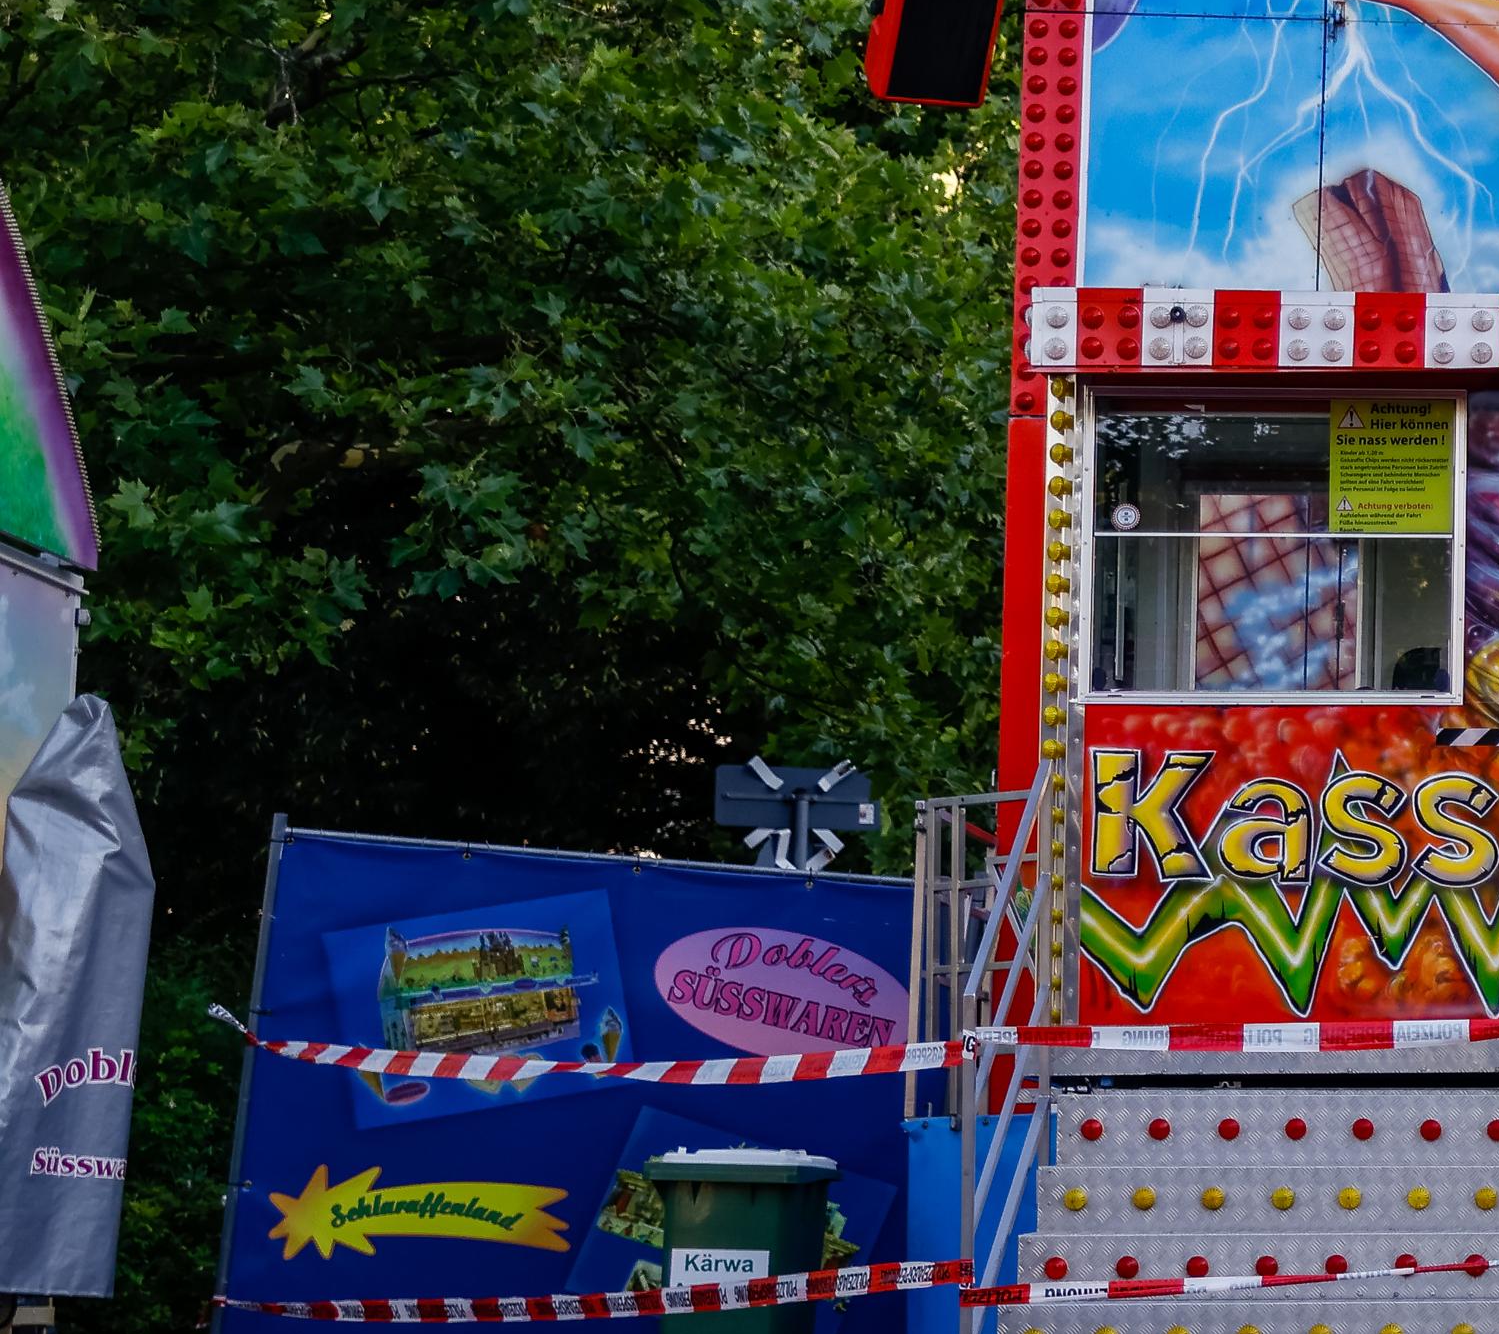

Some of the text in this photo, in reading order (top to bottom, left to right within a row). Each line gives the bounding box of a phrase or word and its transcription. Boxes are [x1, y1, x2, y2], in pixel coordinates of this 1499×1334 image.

[1370, 403, 1431, 417] Achtung!
[1370, 418, 1449, 430] Hier können
[1336, 434, 1355, 446] Sie
[1358, 436, 1387, 446] nass
[1390, 434, 1438, 446] werden
[1357, 502, 1434, 511] Achtung verboten:
[667, 965, 897, 1049] SÜSSWAREN
[34, 1047, 137, 1107] Dobl
[331, 1191, 524, 1232] Schlaraffenland
[685, 1253, 754, 1273] Kärwa
